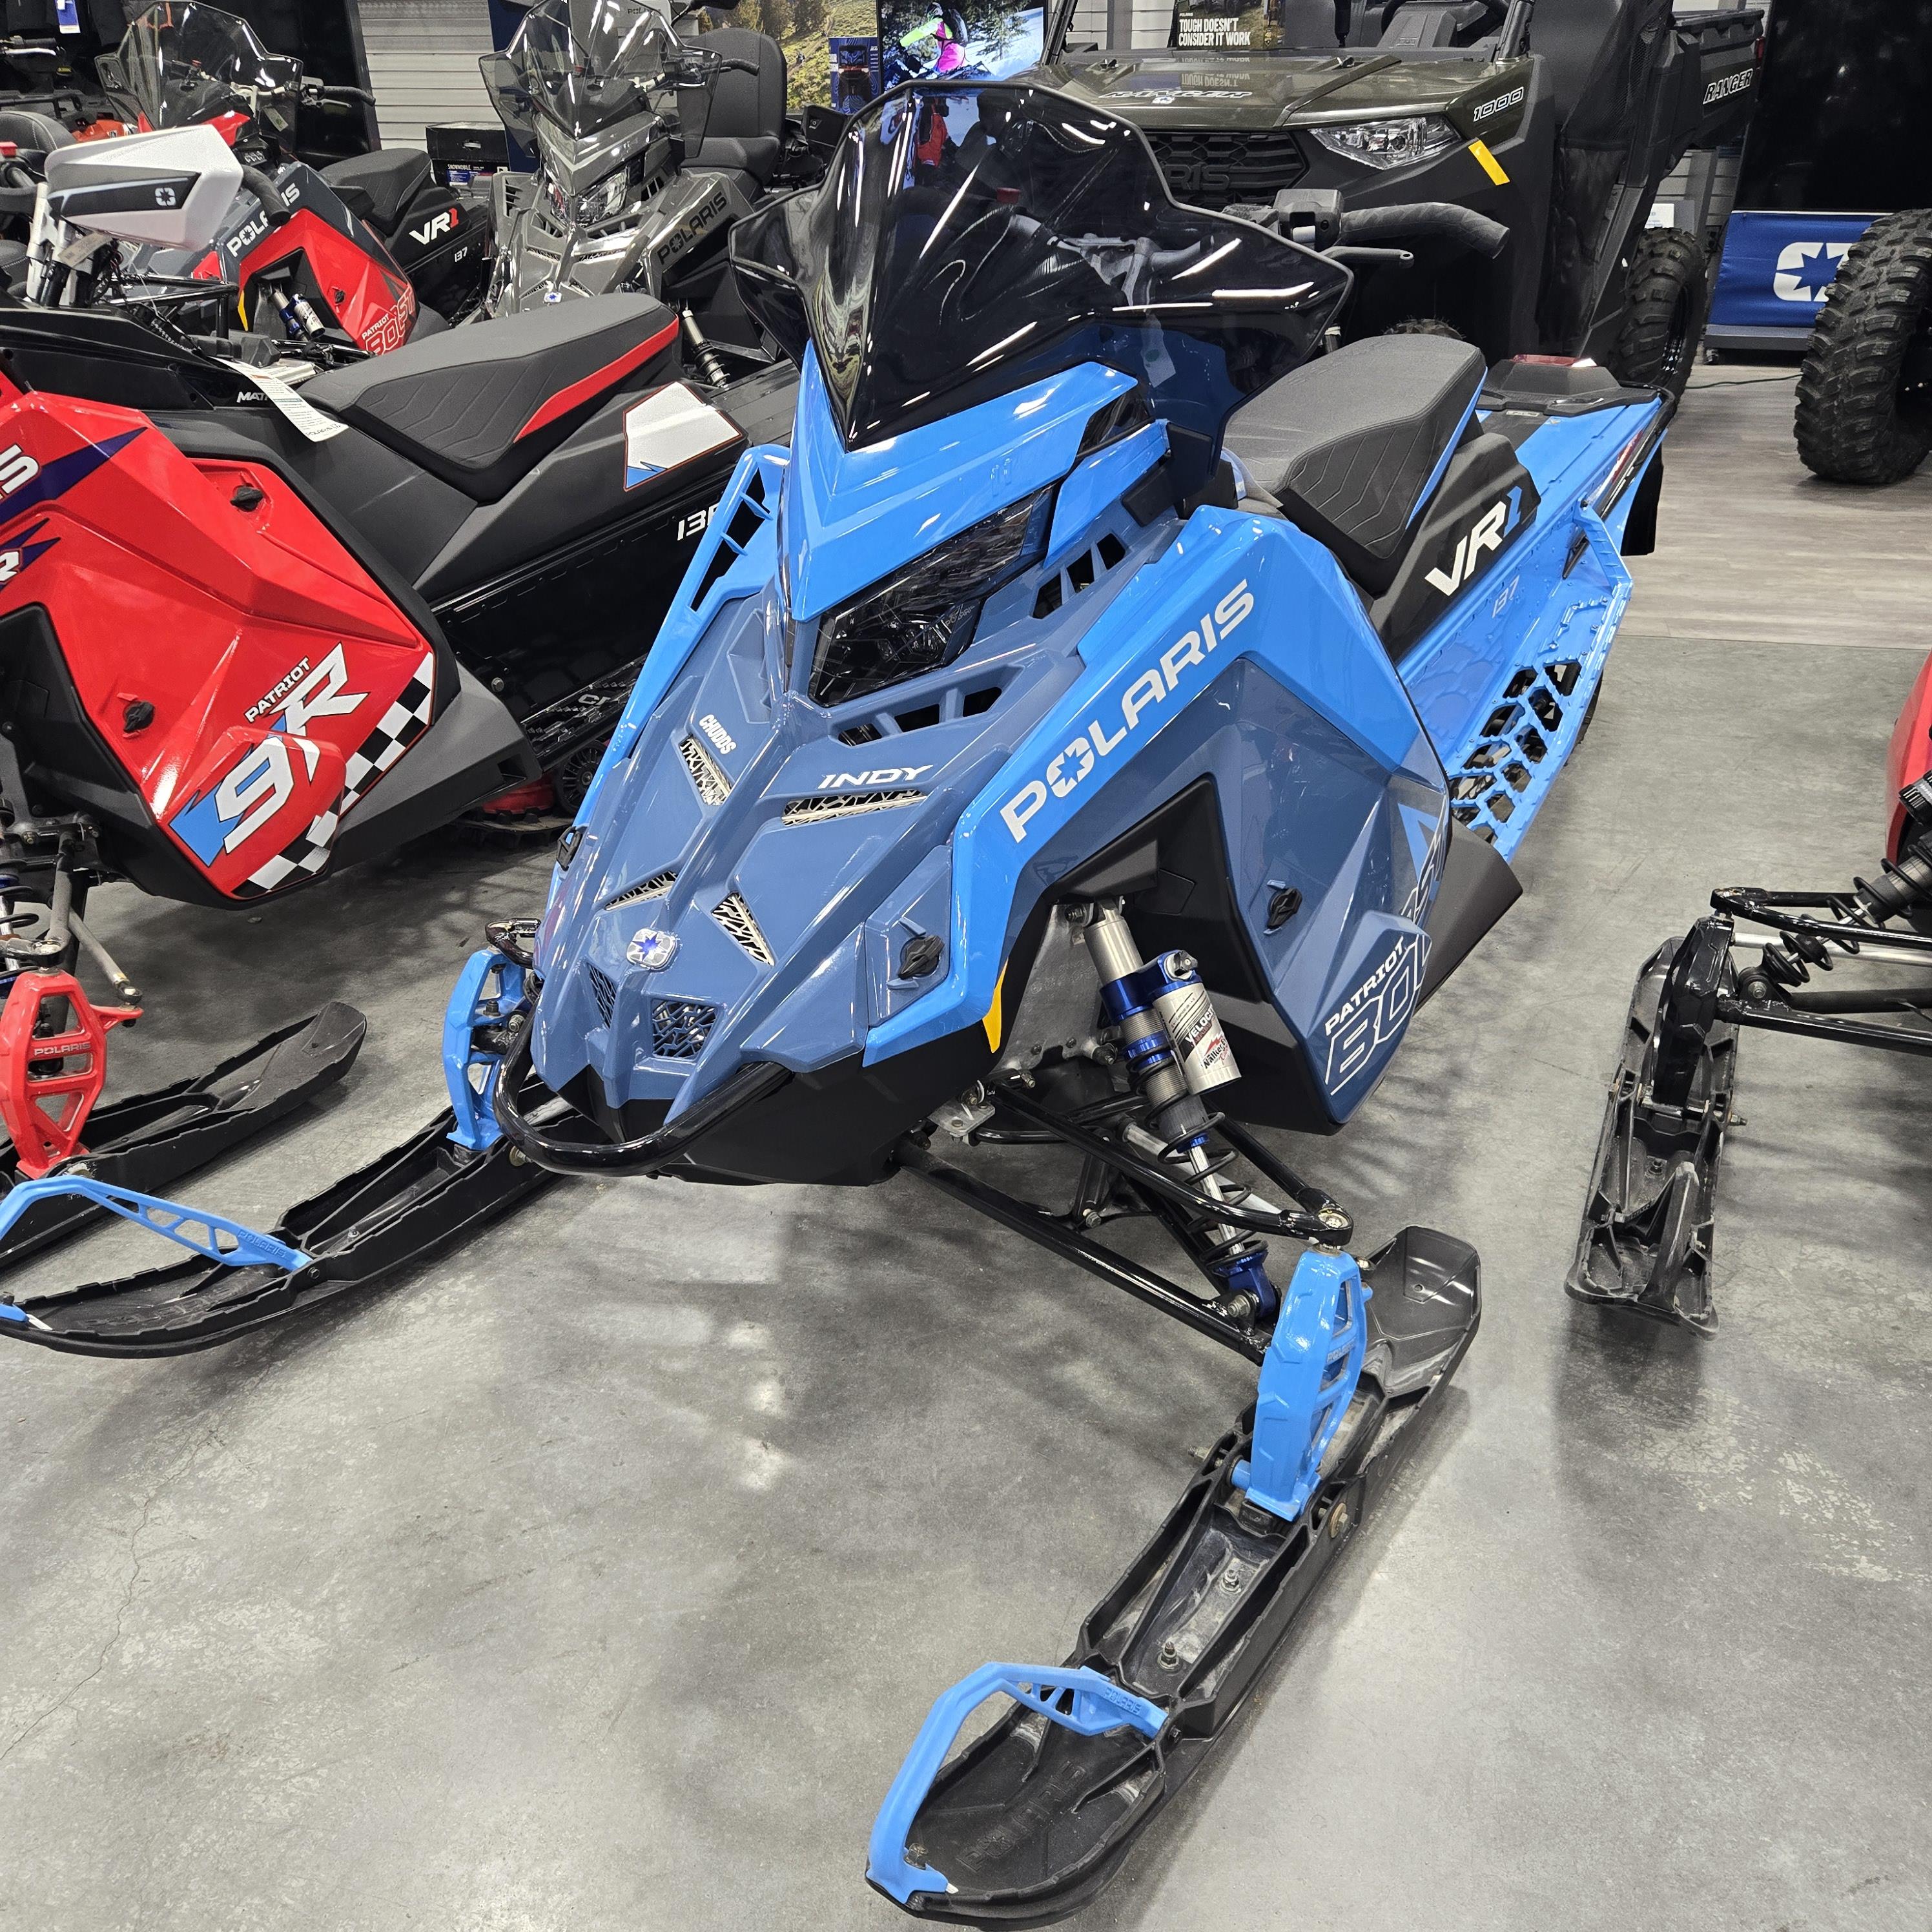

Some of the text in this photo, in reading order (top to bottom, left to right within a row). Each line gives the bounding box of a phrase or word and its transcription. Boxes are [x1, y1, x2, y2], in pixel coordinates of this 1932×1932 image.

[1178, 32, 1251, 46] CONSIDER IT WORK
[1179, 17, 1238, 32] TOUGH DOESN'T
[1703, 68, 1752, 104] RANGER
[1473, 87, 1524, 122] 1000
[409, 208, 459, 245] VR1
[657, 190, 727, 265] POLARIS
[455, 247, 468, 262] 137
[362, 313, 389, 340] PATRIOT
[1425, 486, 1523, 596] VR1
[1492, 575, 1519, 618] 137
[245, 657, 310, 723] PATRIOT
[1000, 579, 1255, 843] POLARIS
[699, 714, 737, 755] CHUDDS
[817, 765, 934, 789] INDY
[1326, 936, 1404, 1035] PATRIOT
[34, 1041, 90, 1056] POLARIS
[237, 1229, 287, 1258] POLARIS
